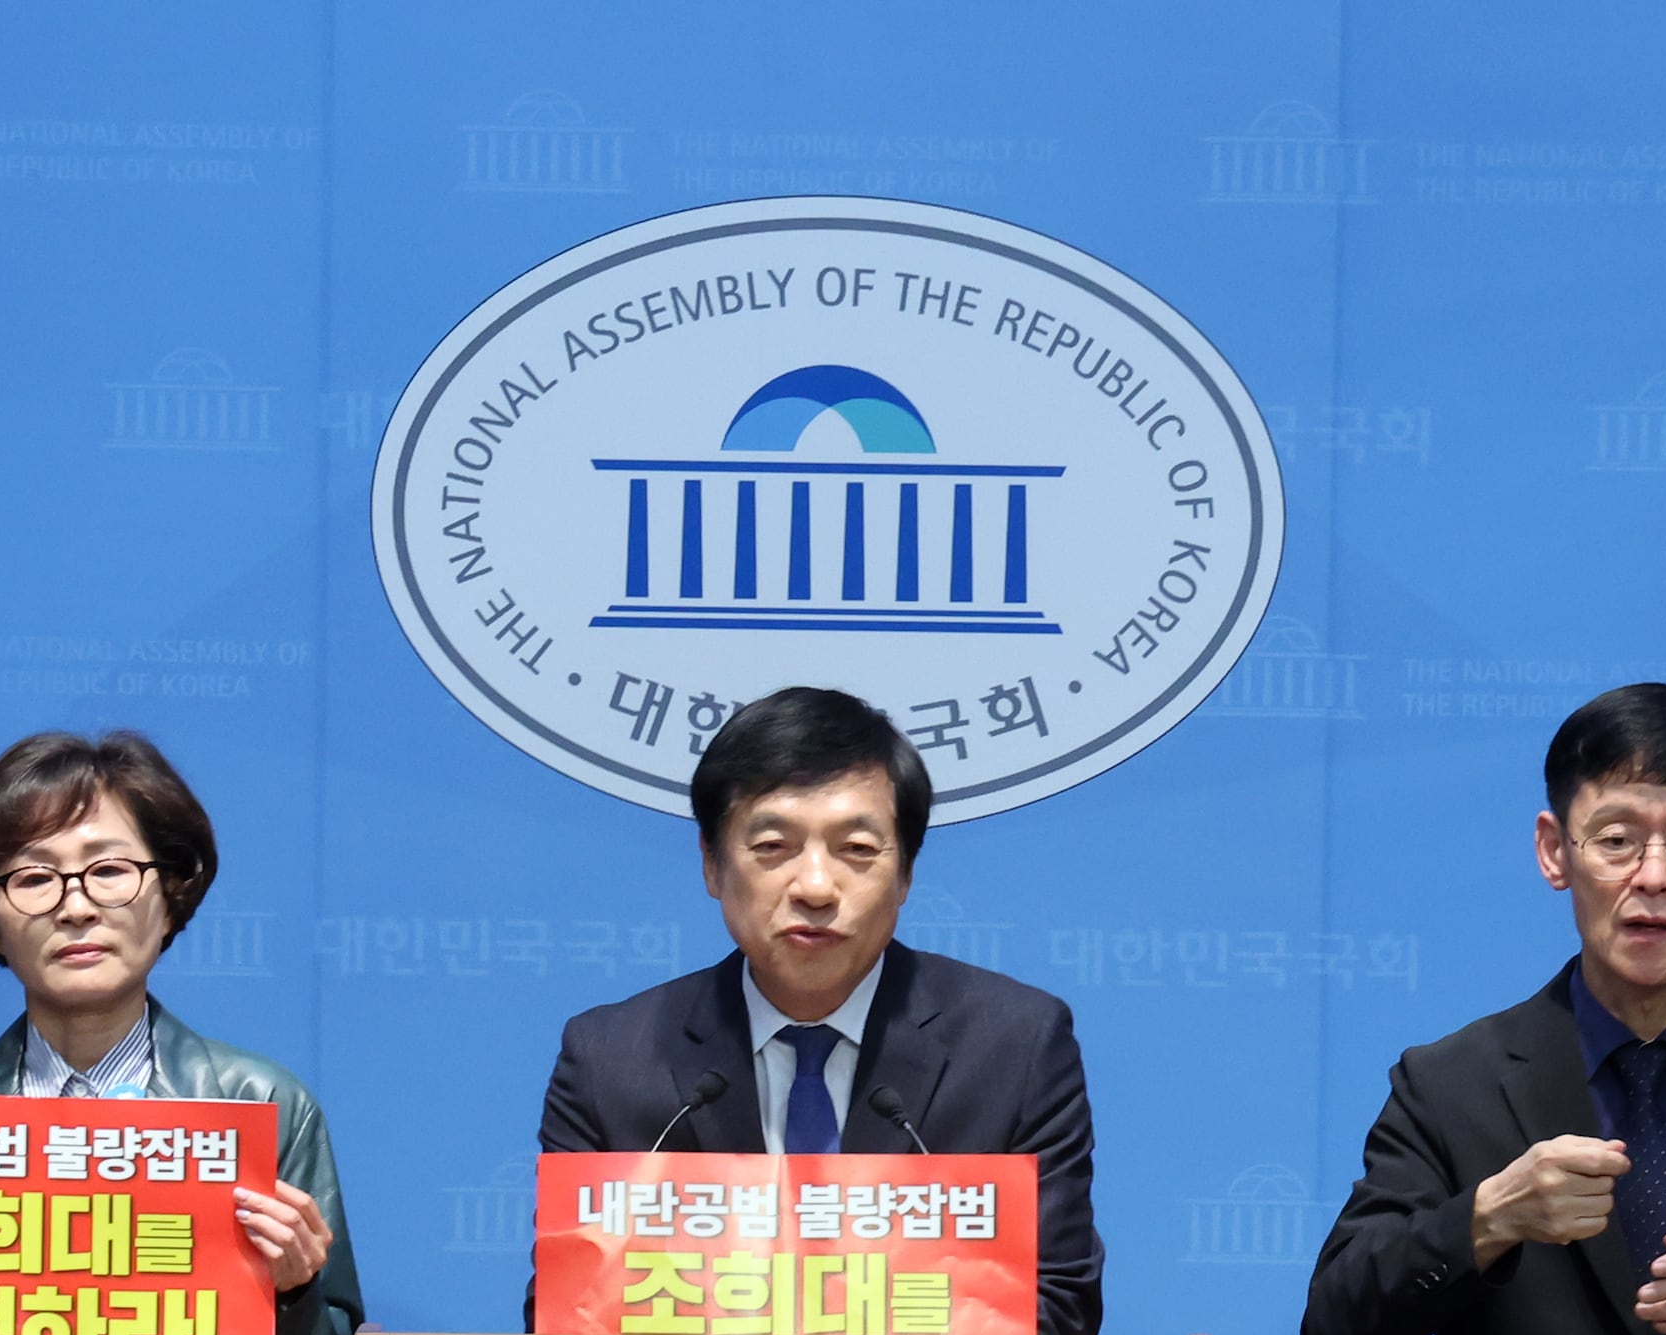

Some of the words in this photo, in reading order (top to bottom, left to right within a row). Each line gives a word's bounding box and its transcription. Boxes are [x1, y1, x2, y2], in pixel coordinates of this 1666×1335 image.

[815, 266, 876, 308] OF
[895, 272, 983, 327] THE
[562, 267, 797, 373] ASSEMBLY
[993, 298, 1187, 452] REPUBLIC
[440, 361, 560, 585] NATIONAL
[1167, 458, 1215, 522] OF
[473, 586, 552, 676] THE
[1093, 537, 1213, 678] KOREA
[608, 670, 1050, 763] 대한국회
[313, 914, 682, 977] 대한민국국회
[1050, 927, 1423, 992] 대한민국국회
[43, 1125, 237, 1182] 불량잡범
[577, 1180, 779, 1239] 내란공범
[795, 1182, 995, 1239] 불량잡범
